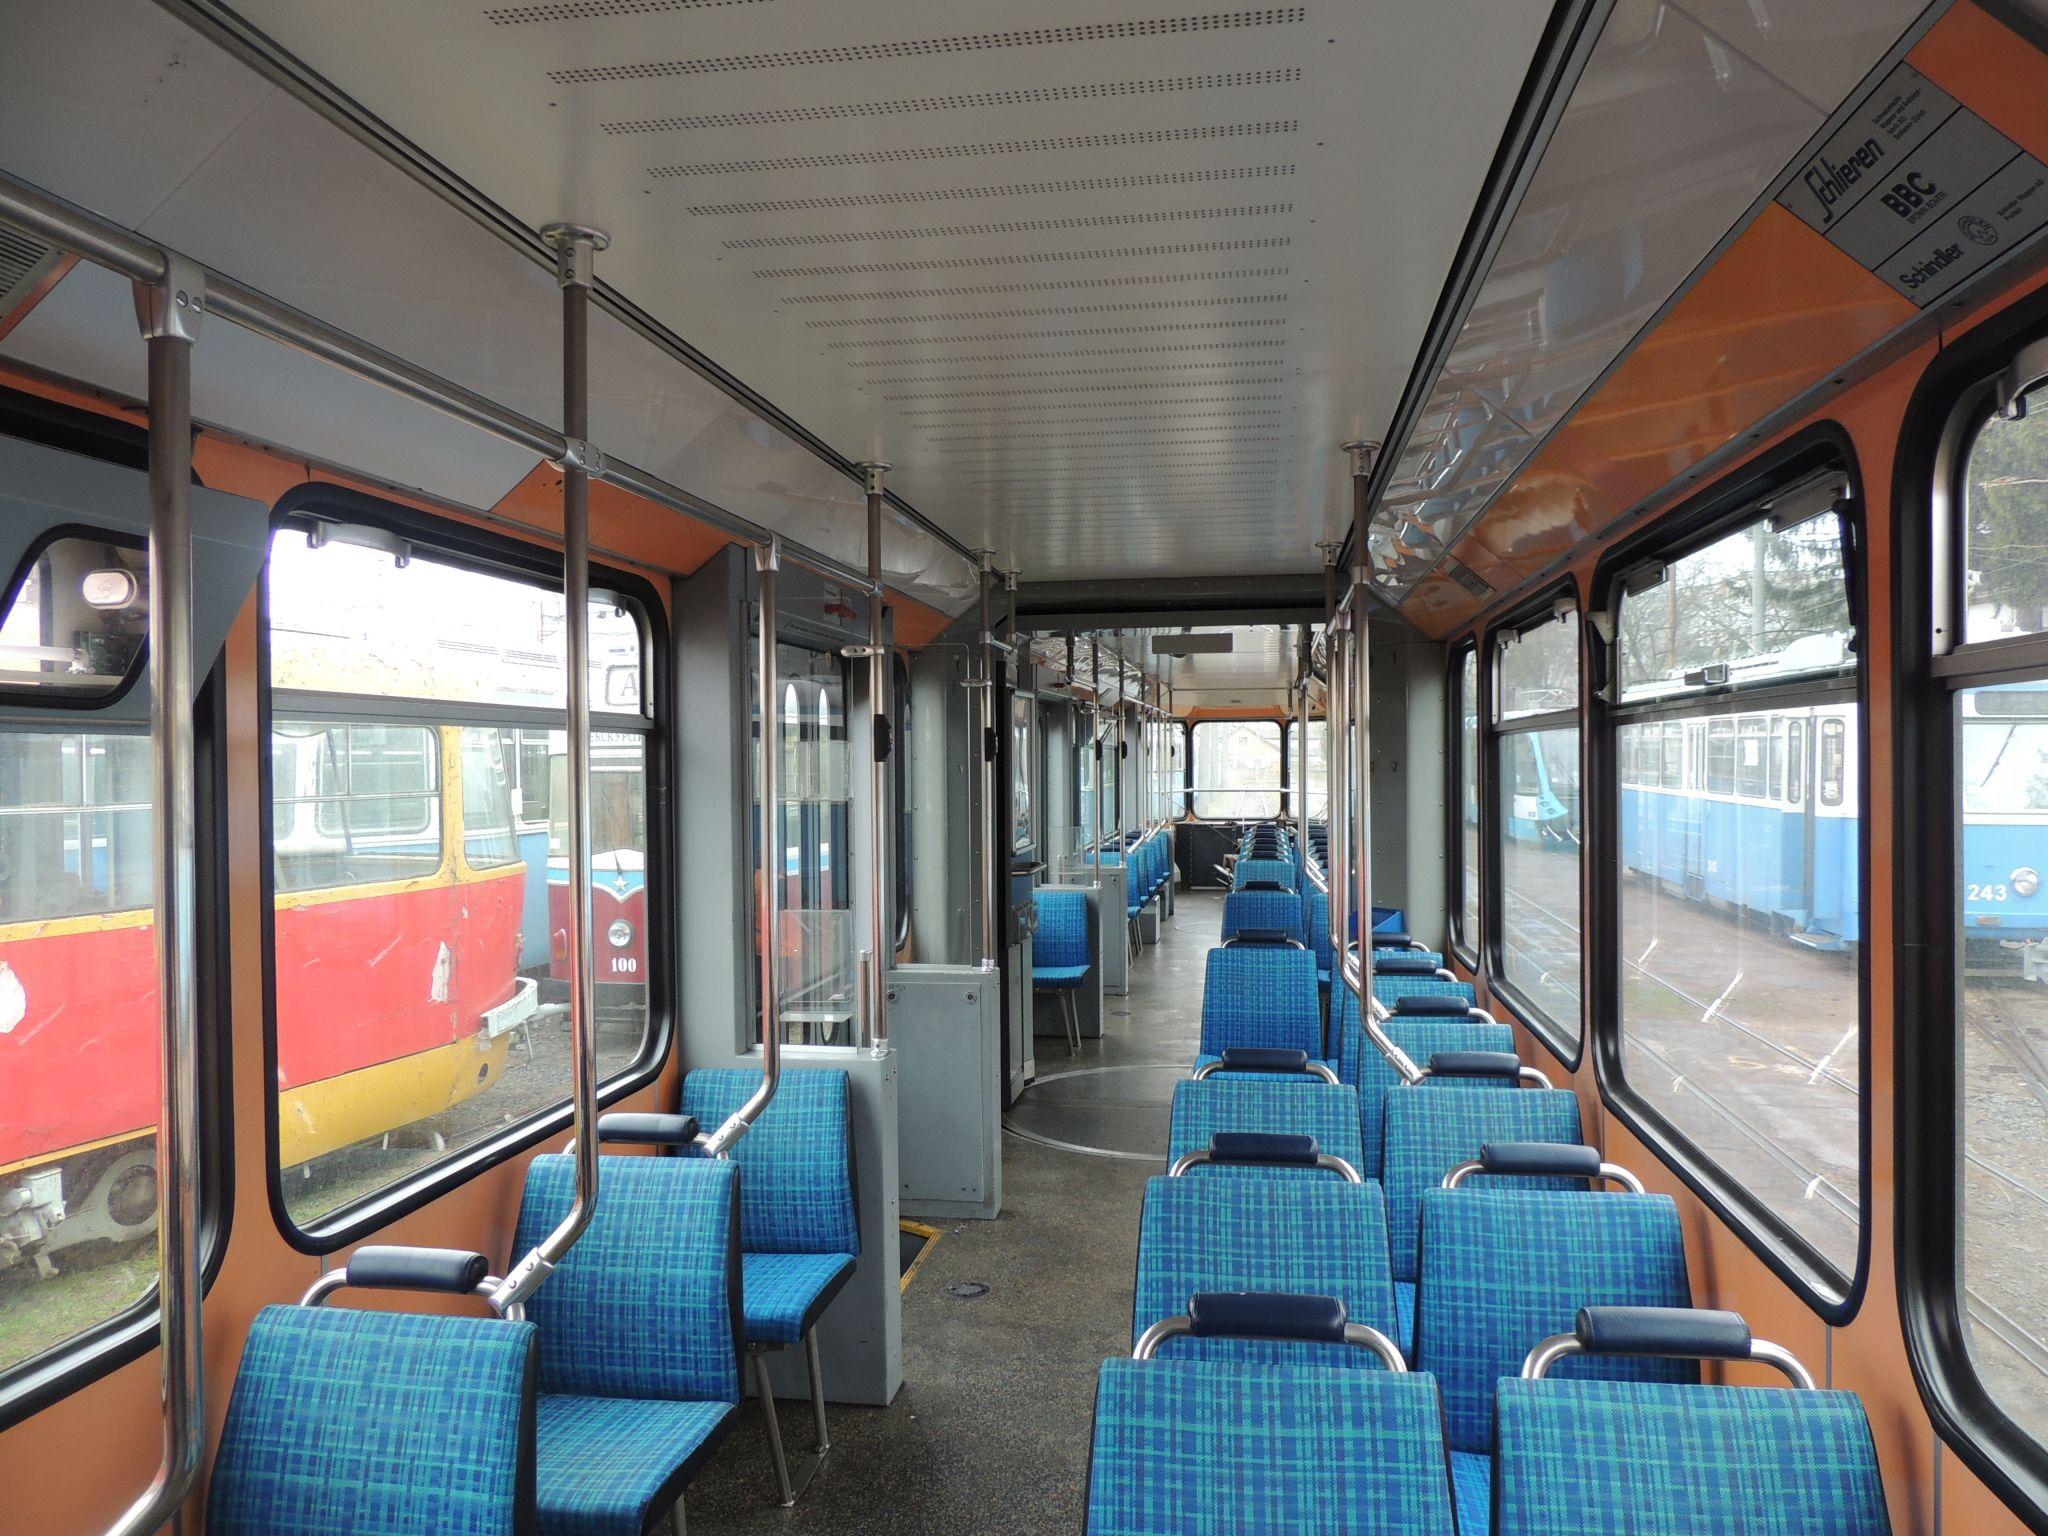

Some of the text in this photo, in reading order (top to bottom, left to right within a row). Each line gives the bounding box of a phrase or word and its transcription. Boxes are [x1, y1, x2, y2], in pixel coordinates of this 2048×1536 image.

[1804, 138, 1884, 224] Schlieren
[1880, 171, 1936, 217] BBC
[1900, 243, 1964, 289] Schindler
[1967, 883, 2008, 901] 243
[611, 957, 637, 973] 100
